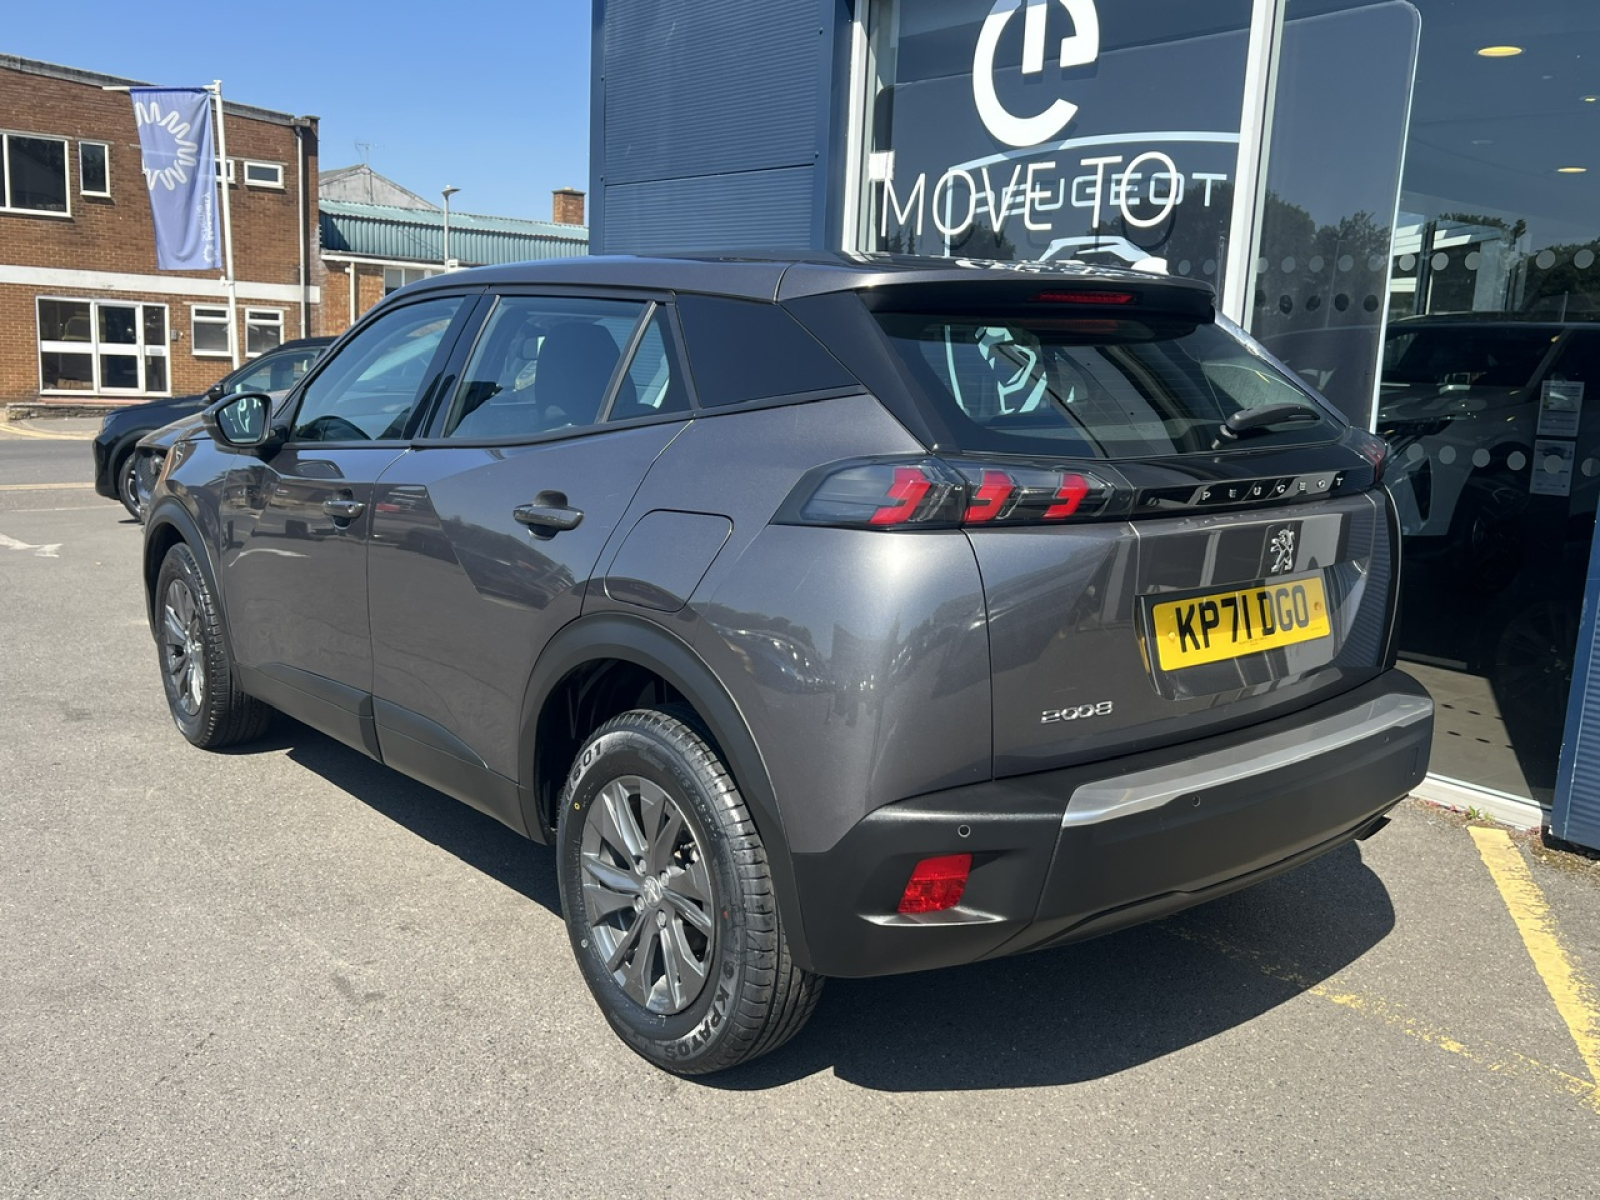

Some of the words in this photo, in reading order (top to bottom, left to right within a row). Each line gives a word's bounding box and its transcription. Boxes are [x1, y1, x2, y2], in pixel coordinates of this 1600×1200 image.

[881, 160, 1056, 237] MOVE
[1080, 151, 1178, 229] TO
[1201, 476, 1344, 501] PEUGEOT
[1175, 594, 1253, 653] KP71
[1256, 584, 1310, 637] DGO
[1040, 700, 1113, 724] 2008
